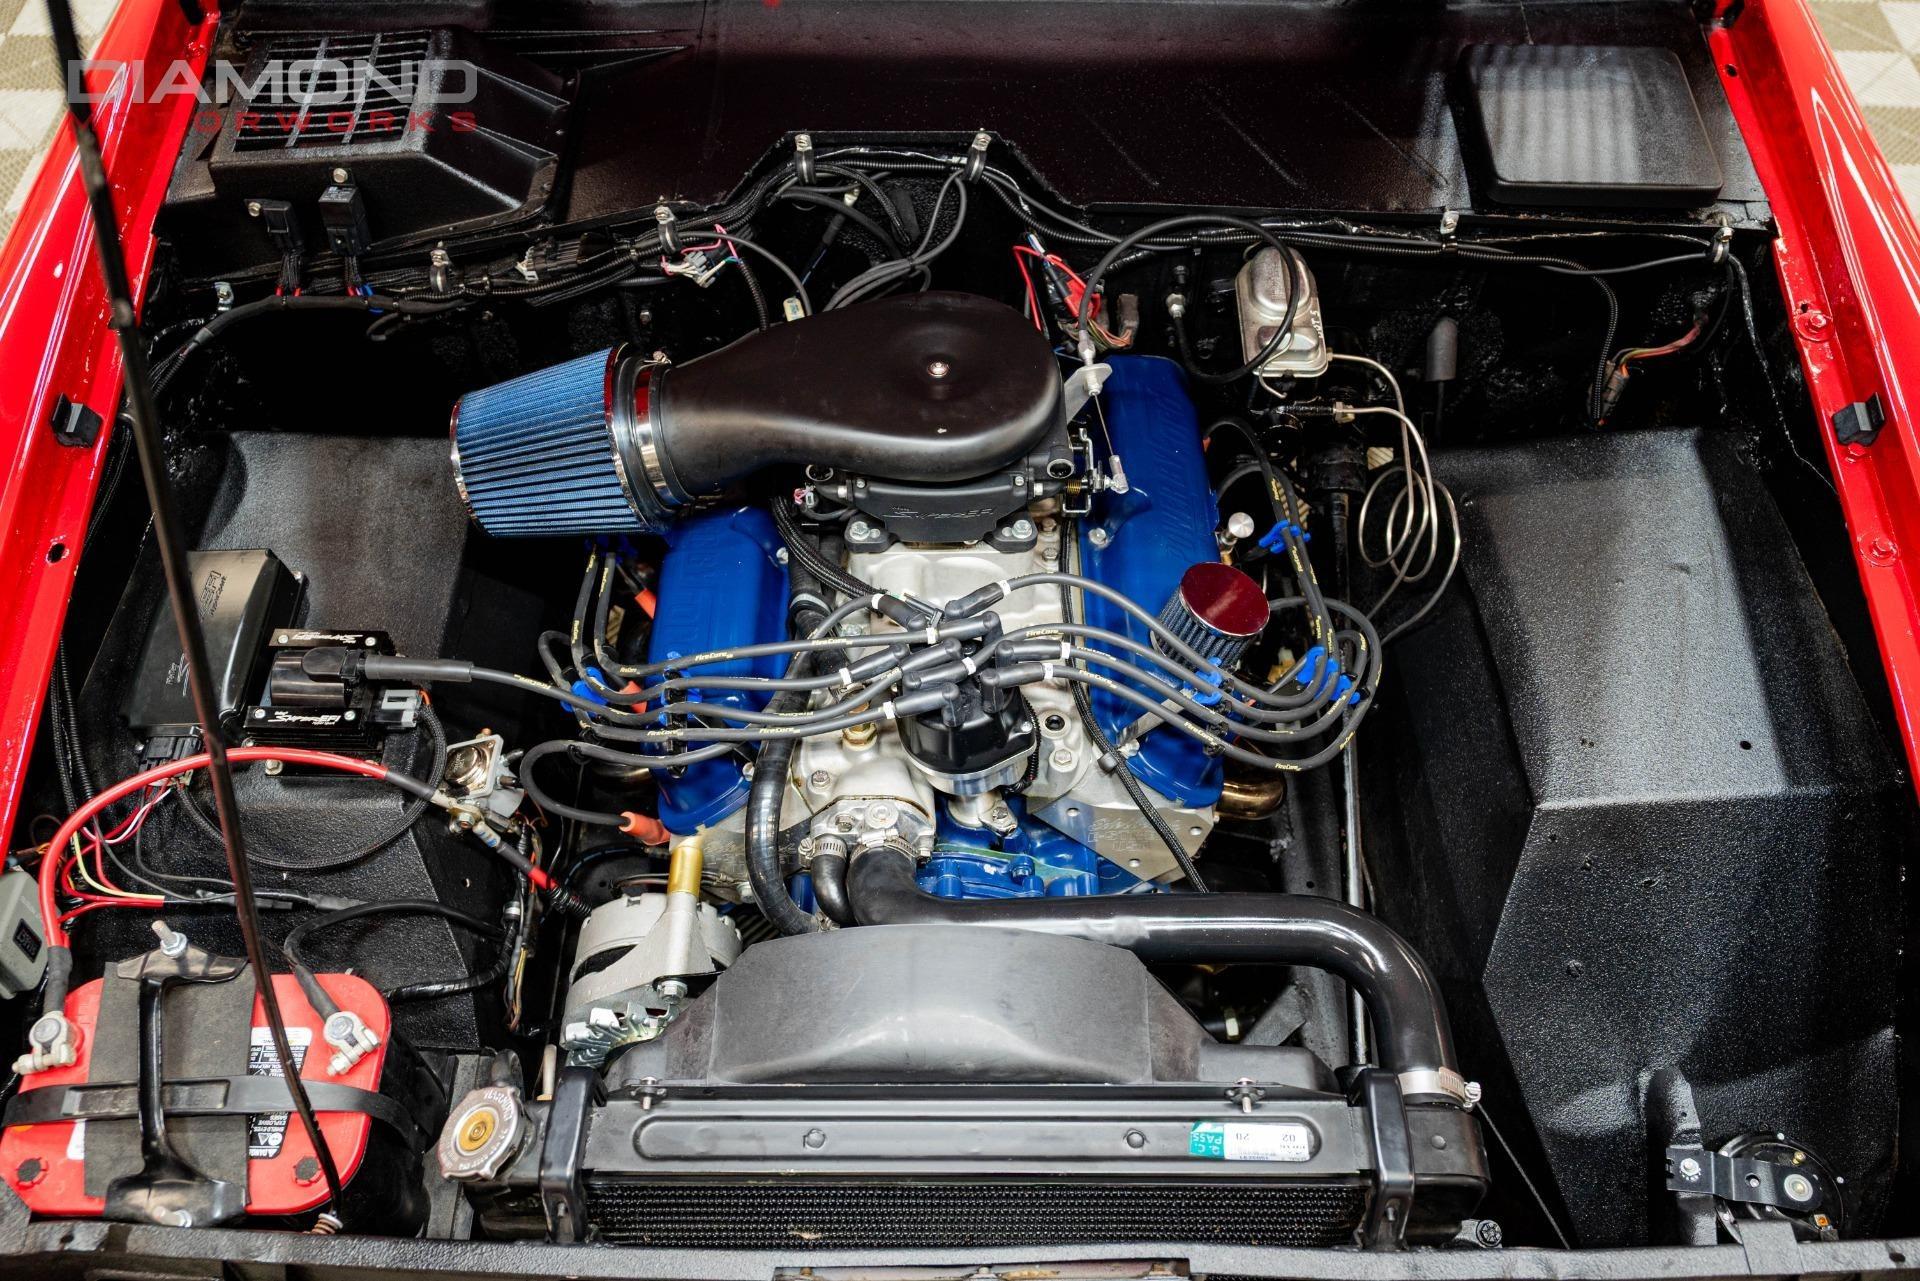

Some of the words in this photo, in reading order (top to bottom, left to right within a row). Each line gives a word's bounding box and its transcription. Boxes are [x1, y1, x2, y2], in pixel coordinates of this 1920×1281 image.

[1025, 628, 1059, 638] FireCore
[811, 638, 847, 646] FireCore
[694, 651, 727, 661] FireCore
[1192, 1131, 1224, 1145] PASS
